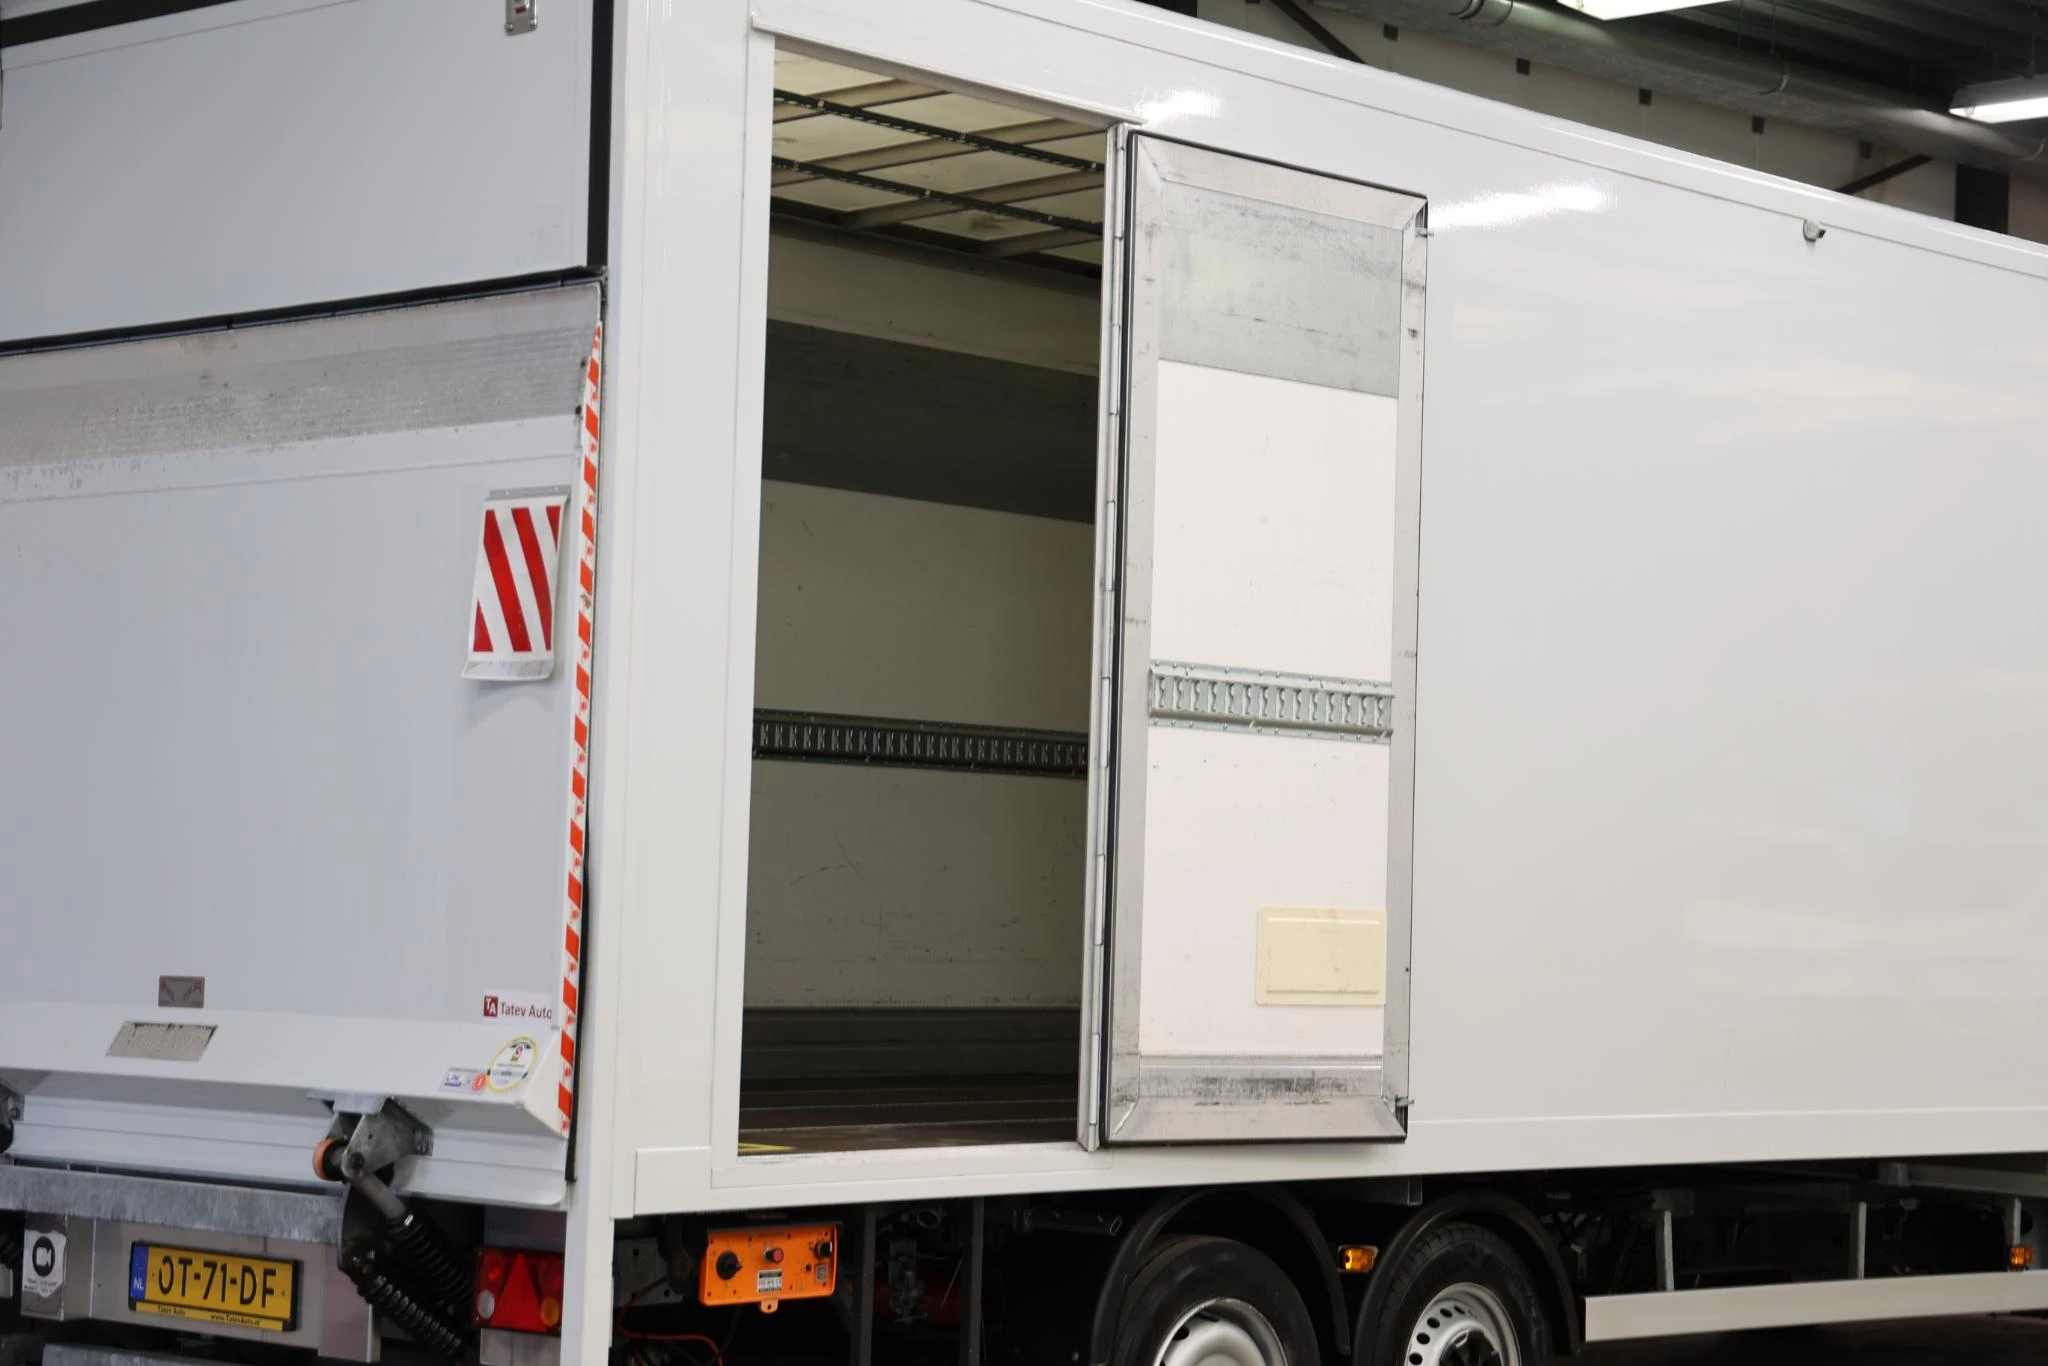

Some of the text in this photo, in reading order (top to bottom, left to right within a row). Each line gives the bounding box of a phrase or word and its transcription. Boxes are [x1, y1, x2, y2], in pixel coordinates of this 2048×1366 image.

[500, 1002, 527, 1017] Tatev
[528, 1004, 553, 1019] Auto
[133, 1276, 144, 1290] NL
[158, 1255, 277, 1309] OT-71-DF
[173, 1306, 186, 1316] Auto
